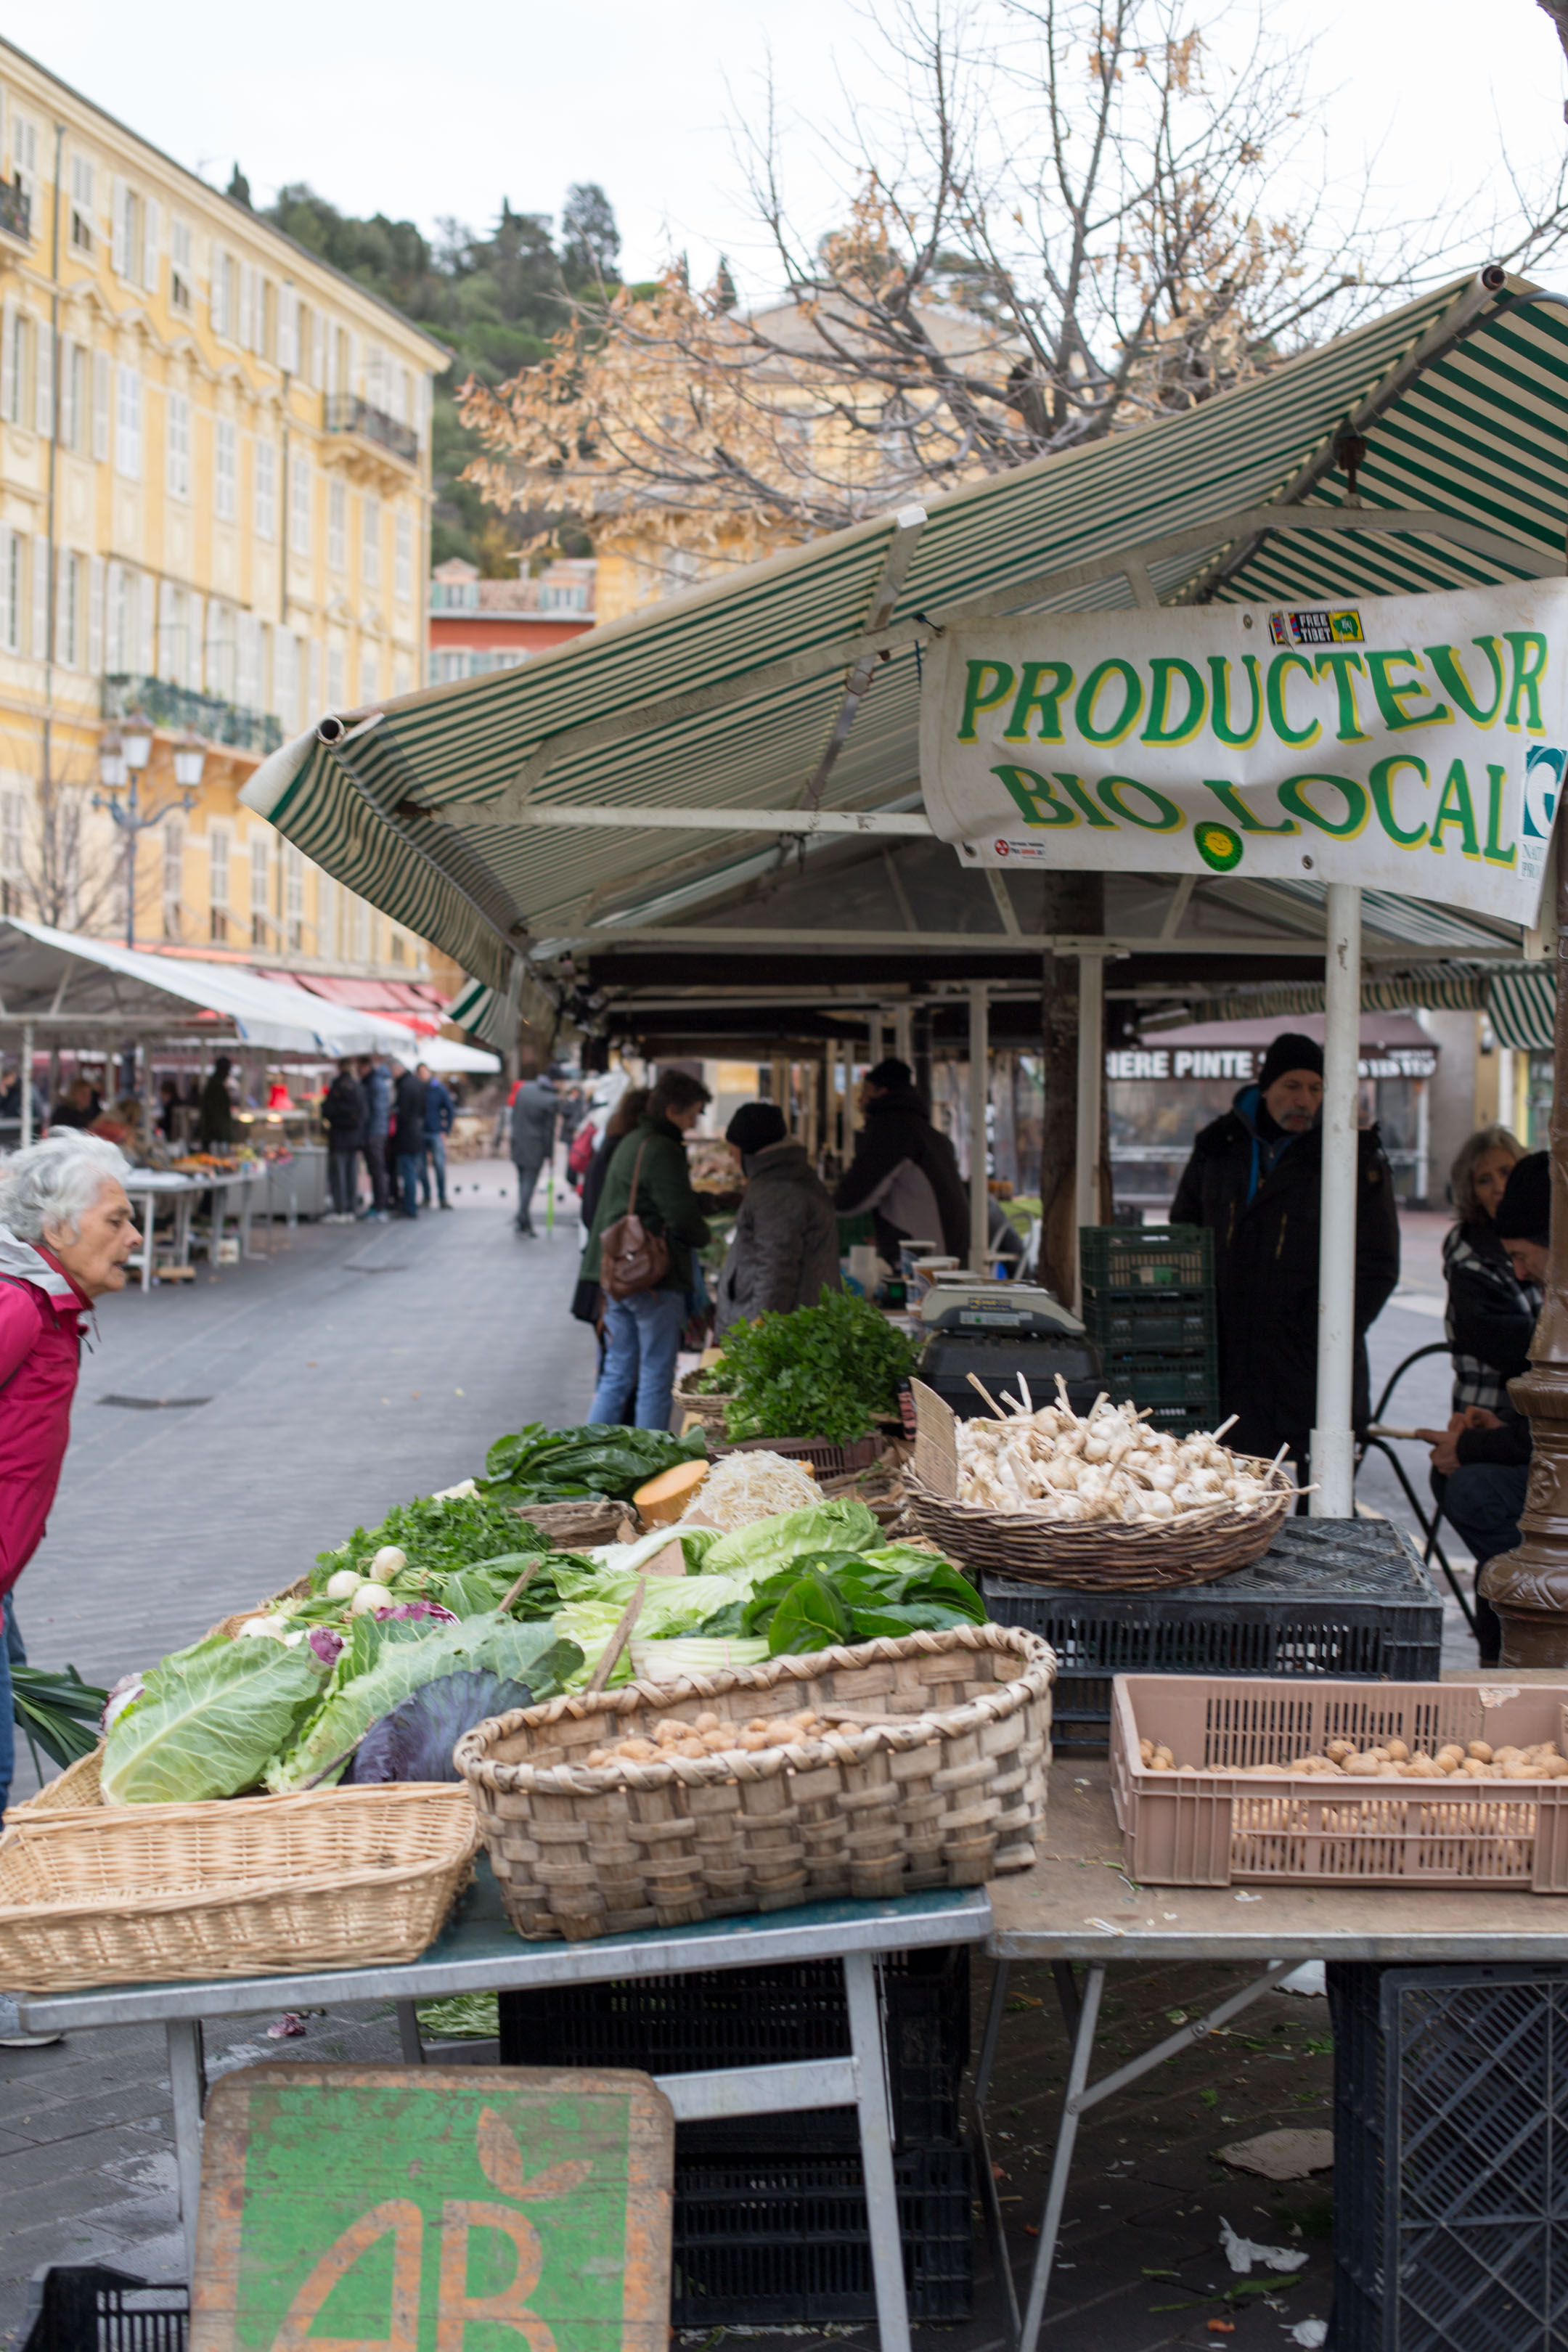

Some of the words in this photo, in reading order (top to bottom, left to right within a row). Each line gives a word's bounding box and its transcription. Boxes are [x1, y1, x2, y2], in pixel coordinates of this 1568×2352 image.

[1298, 613, 1328, 627] FREE
[1300, 627, 1331, 642] TIBET
[957, 631, 1549, 750] PRODUCTEUR
[990, 764, 1187, 833] BIO
[1204, 754, 1519, 869] LOCAL
[1173, 1050, 1254, 1079] PINTE
[268, 2197, 558, 2352] AB
